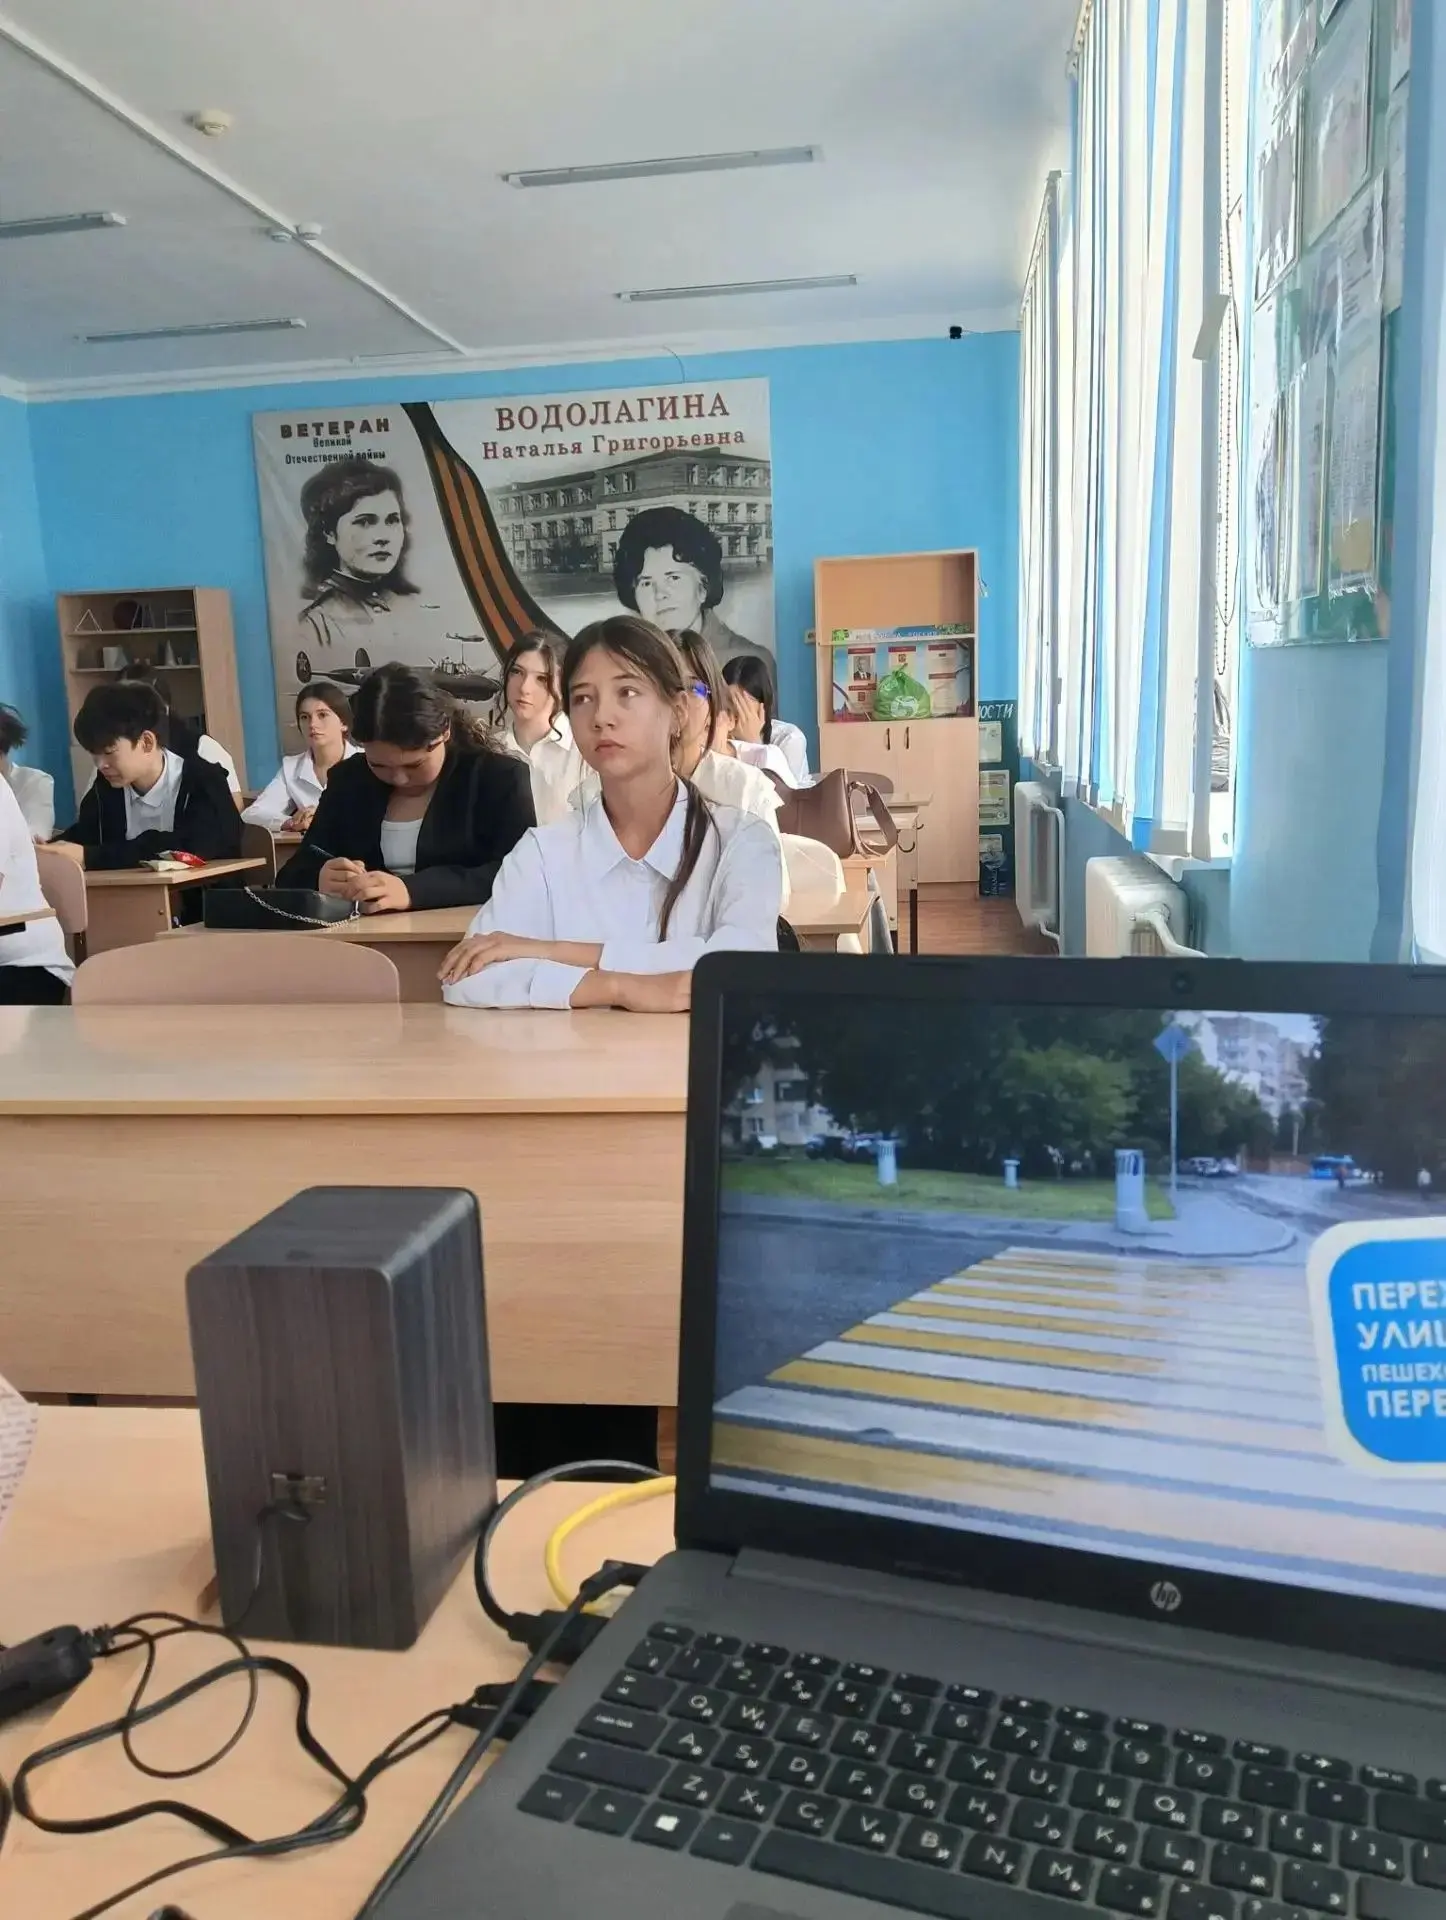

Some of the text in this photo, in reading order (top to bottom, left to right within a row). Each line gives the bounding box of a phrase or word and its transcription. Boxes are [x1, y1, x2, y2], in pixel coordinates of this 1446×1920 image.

[495, 392, 730, 433] ВОДОЛАГИНА
[280, 418, 390, 438] ВЕТЕРАН
[313, 435, 352, 448] Великой
[482, 430, 745, 460] Наталья Григорьевна
[285, 450, 354, 465] Отечественной
[979, 703, 1014, 719] ОСТИ
[1361, 1362, 1446, 1383] ПЕШЕХ
[1150, 1580, 1181, 1610] hp
